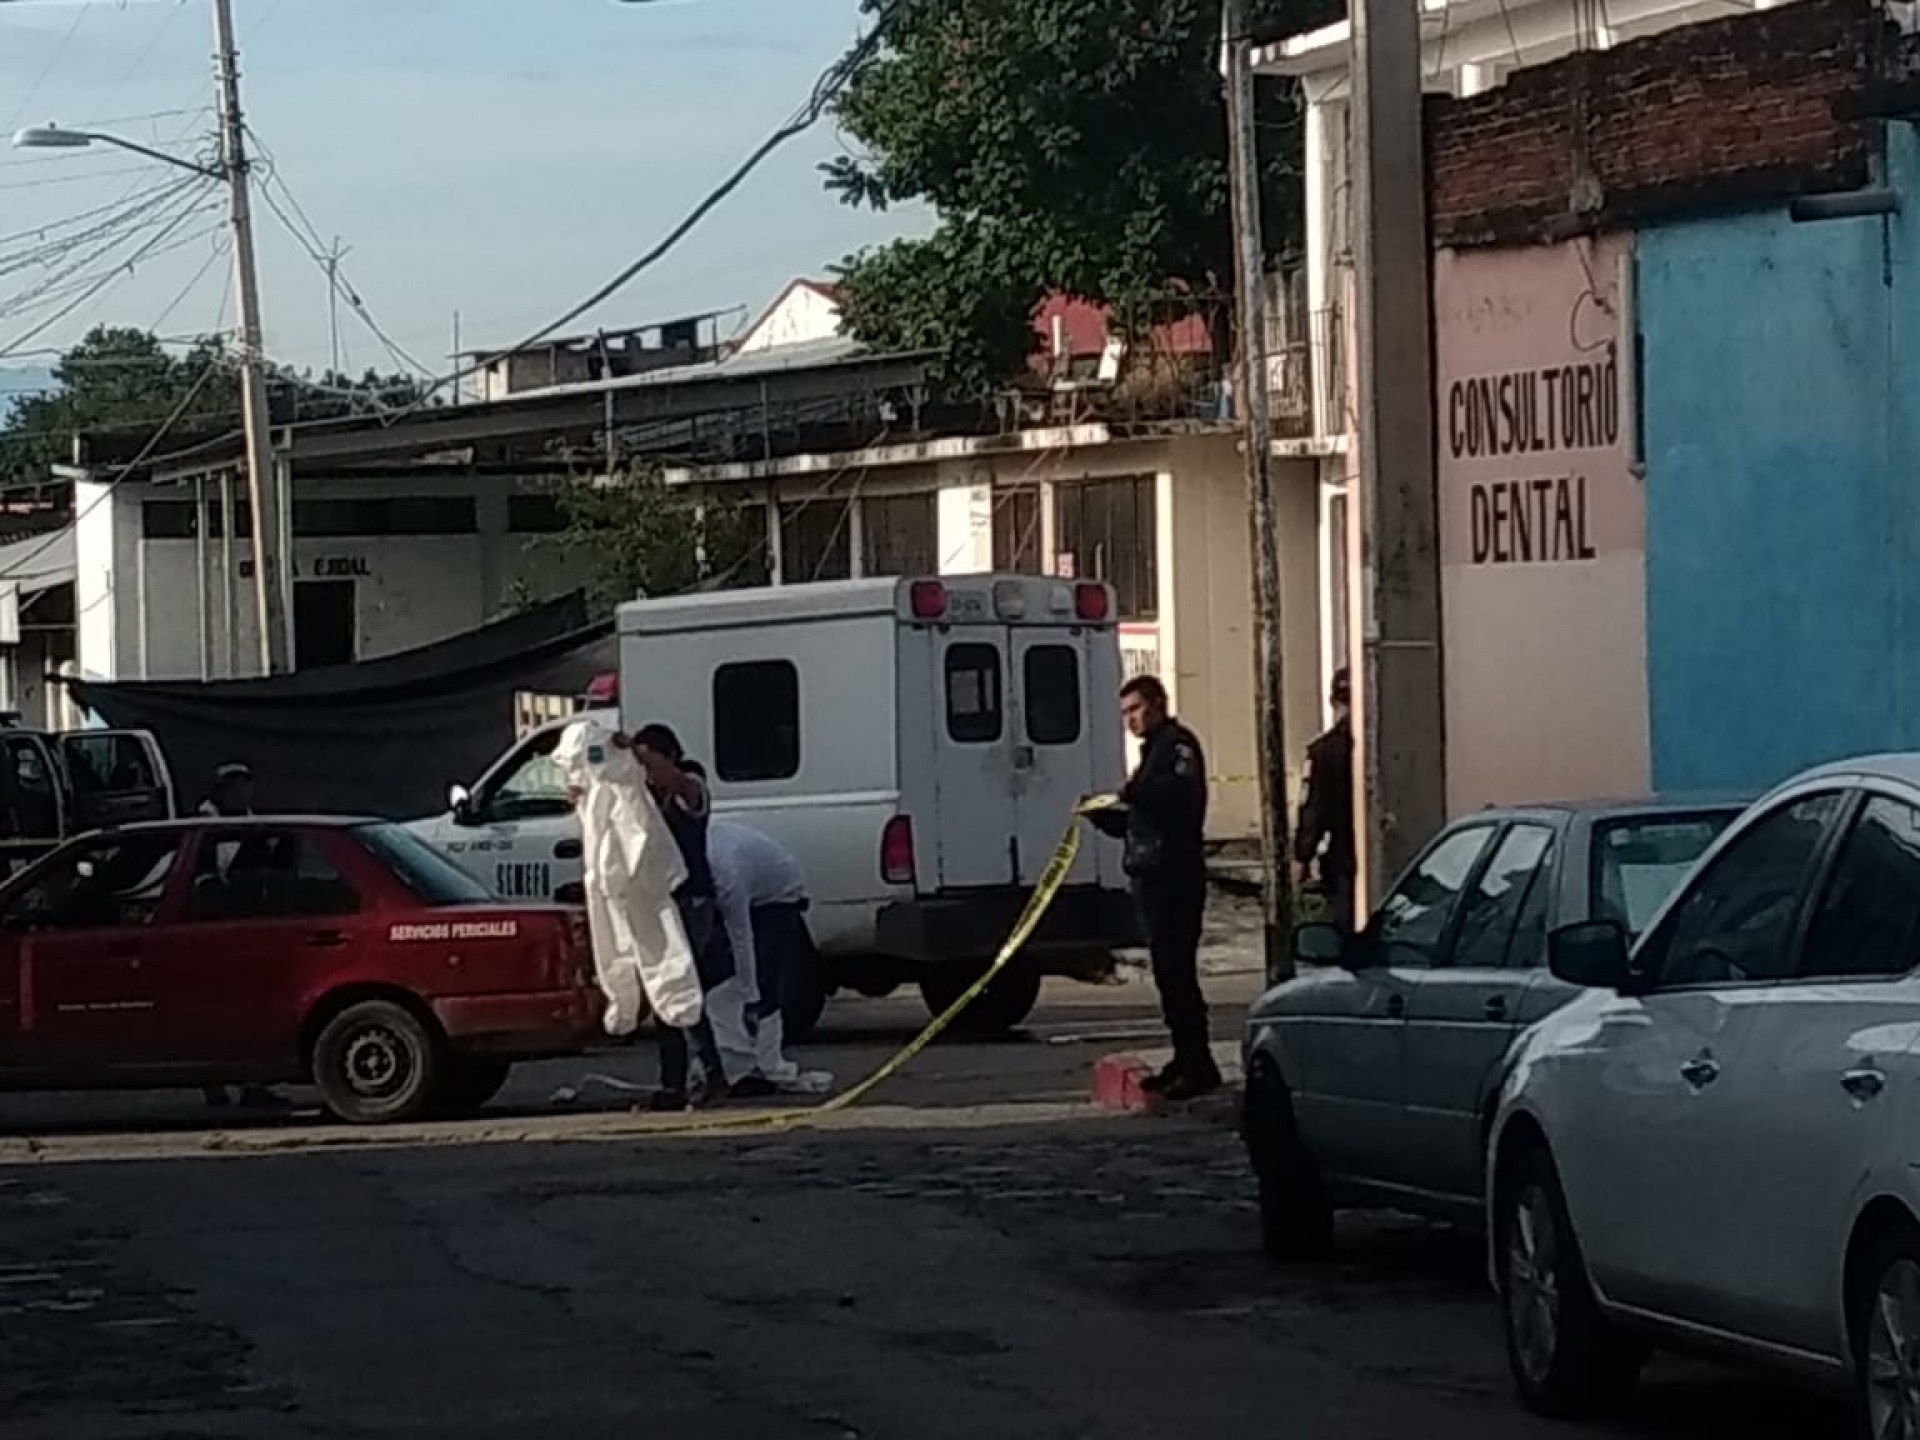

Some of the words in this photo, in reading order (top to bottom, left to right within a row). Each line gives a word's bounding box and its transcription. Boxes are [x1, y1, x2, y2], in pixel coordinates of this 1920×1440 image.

[1450, 363, 1618, 458] CONSULTORIO
[1471, 476, 1596, 564] DENTAL
[314, 557, 371, 576] EJIDAL
[497, 862, 549, 897] SEMEFO
[389, 923, 449, 941] SERVICIOS
[452, 920, 517, 938] PERICIALES
